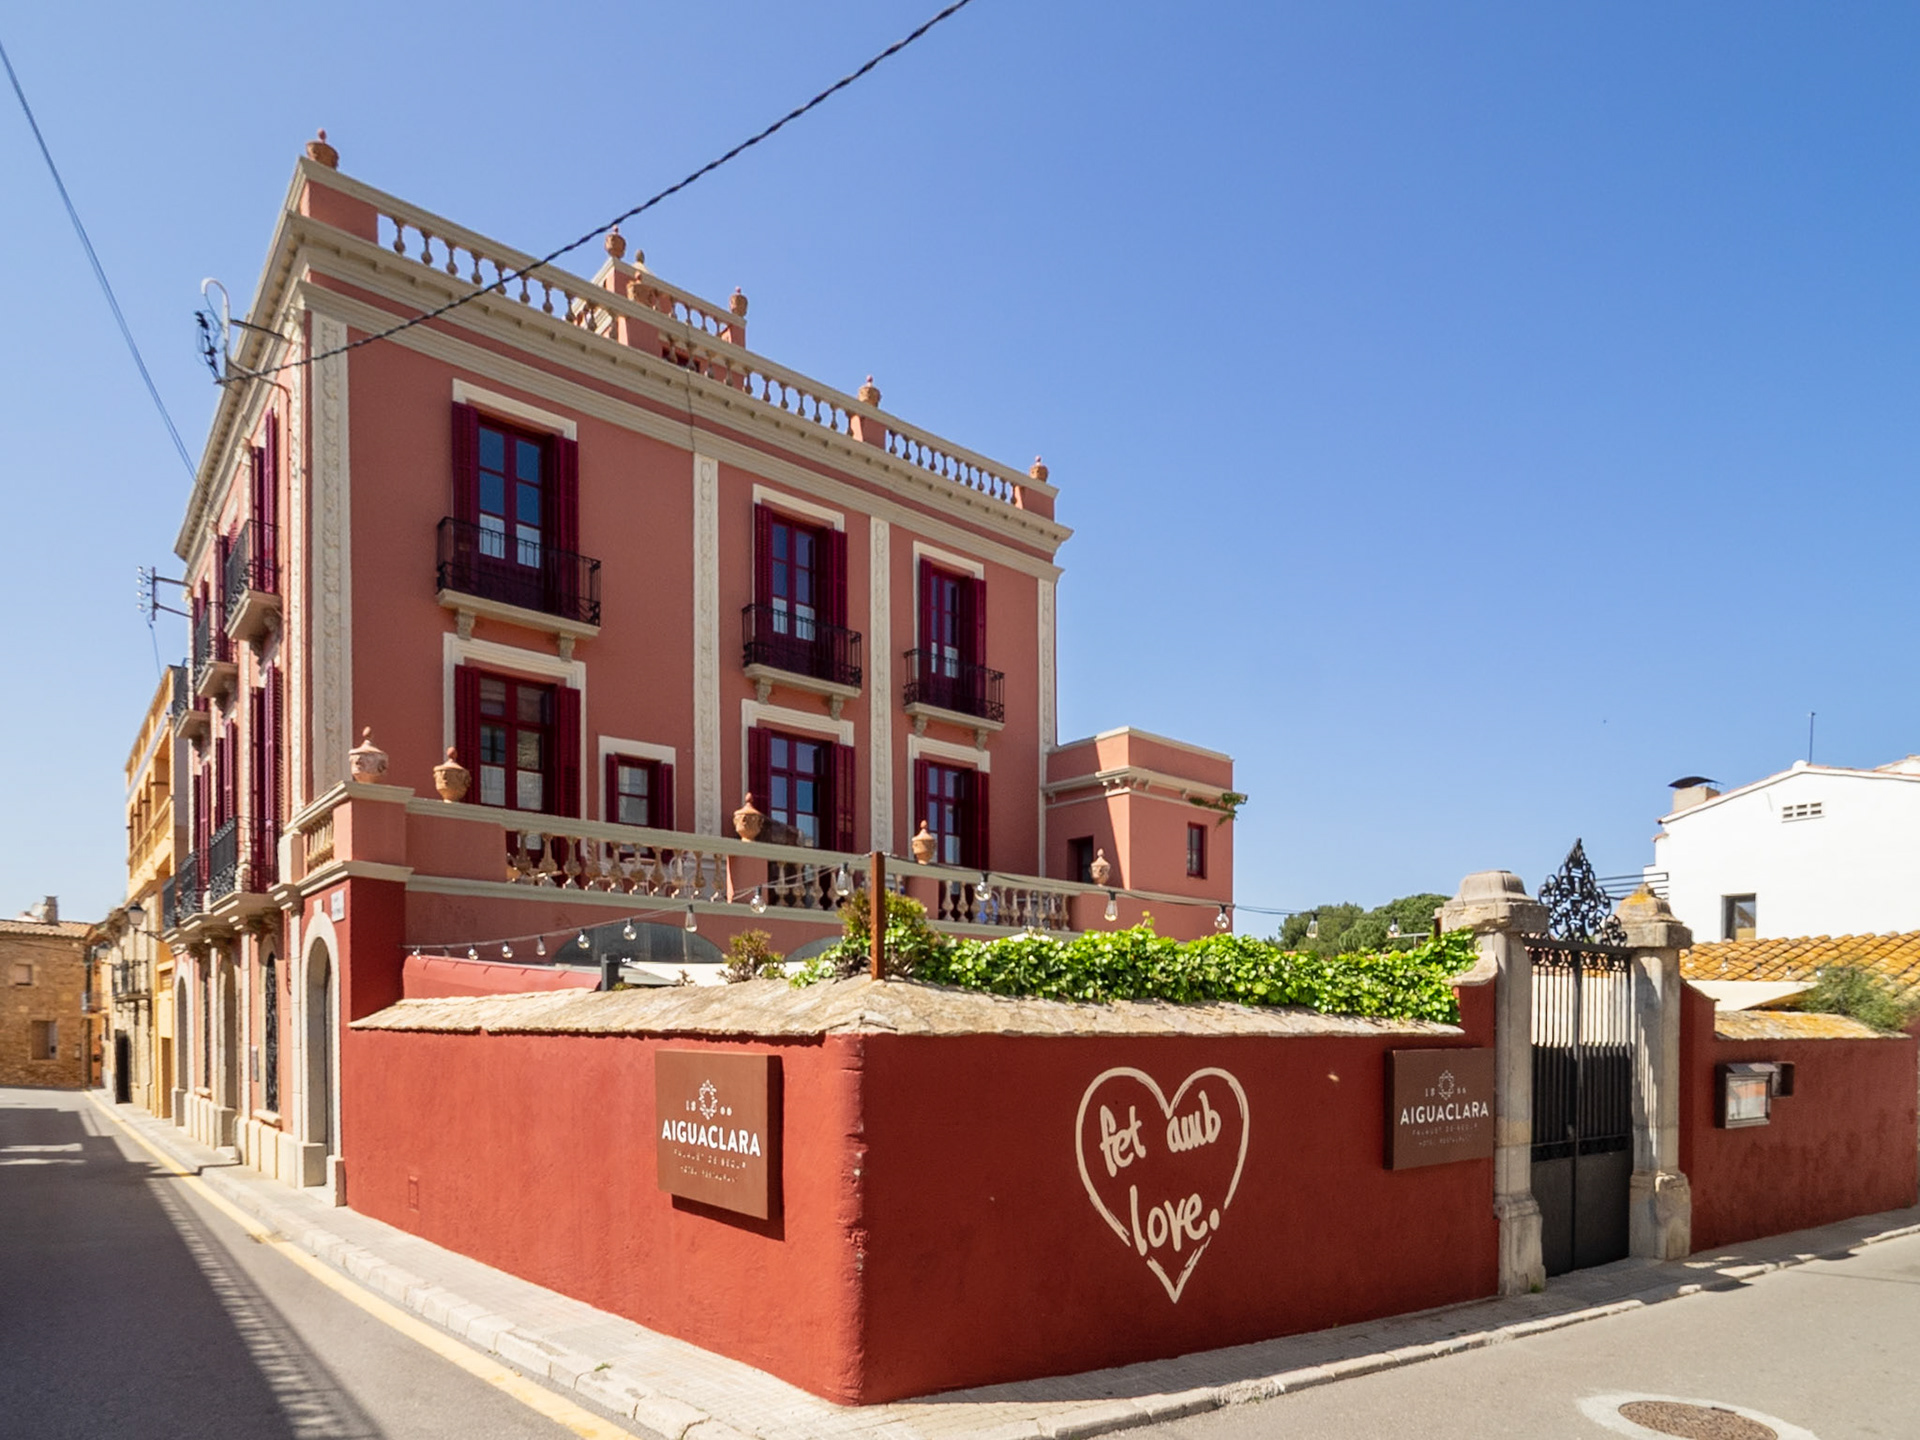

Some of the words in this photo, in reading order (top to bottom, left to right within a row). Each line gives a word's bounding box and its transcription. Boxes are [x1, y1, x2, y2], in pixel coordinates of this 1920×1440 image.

[662, 1119, 761, 1157] AIGUACLARA
[1099, 1104, 1147, 1178] fet
[1400, 1102, 1489, 1126] AIGUACLARA
[1128, 1184, 1220, 1257] love.
